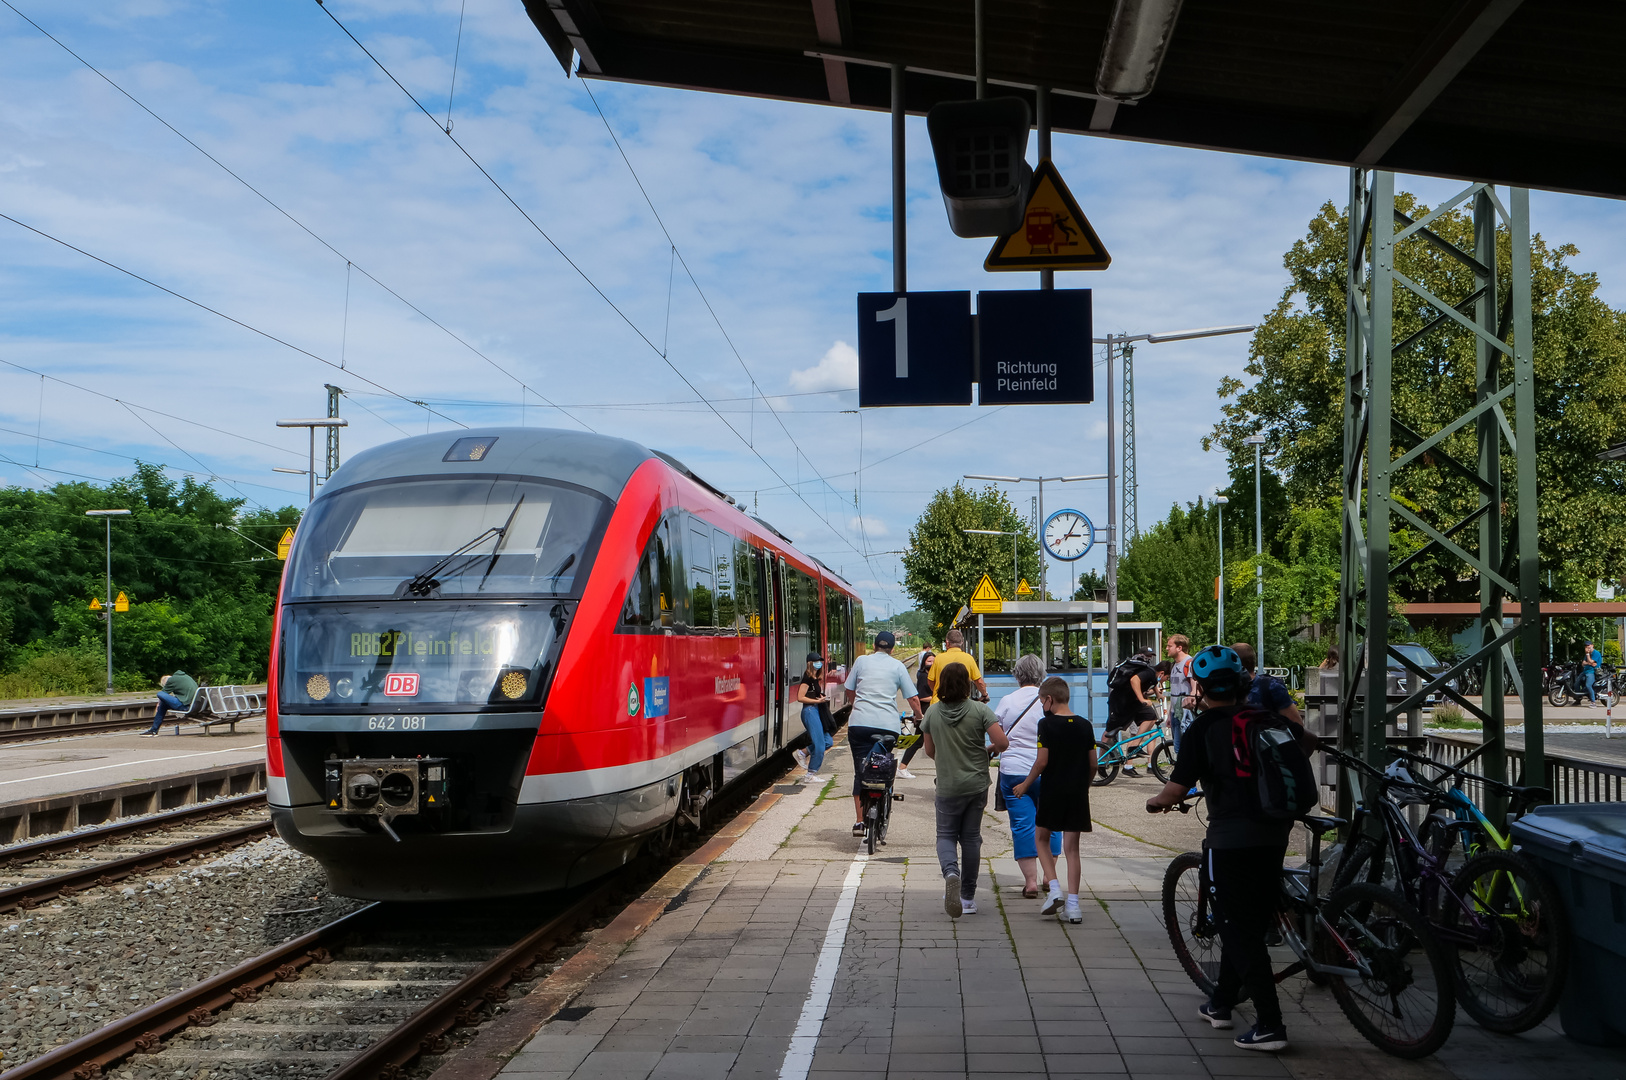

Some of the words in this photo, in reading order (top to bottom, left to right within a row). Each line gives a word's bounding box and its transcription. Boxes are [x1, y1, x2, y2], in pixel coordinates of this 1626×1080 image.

[876, 297, 908, 378] 1
[997, 361, 1057, 377] Richtung
[997, 378, 1057, 391] Pleinfeld
[351, 632, 392, 656] RB62
[393, 631, 493, 656] Pleinfeld
[368, 716, 395, 730] 642
[402, 716, 426, 730] 081
